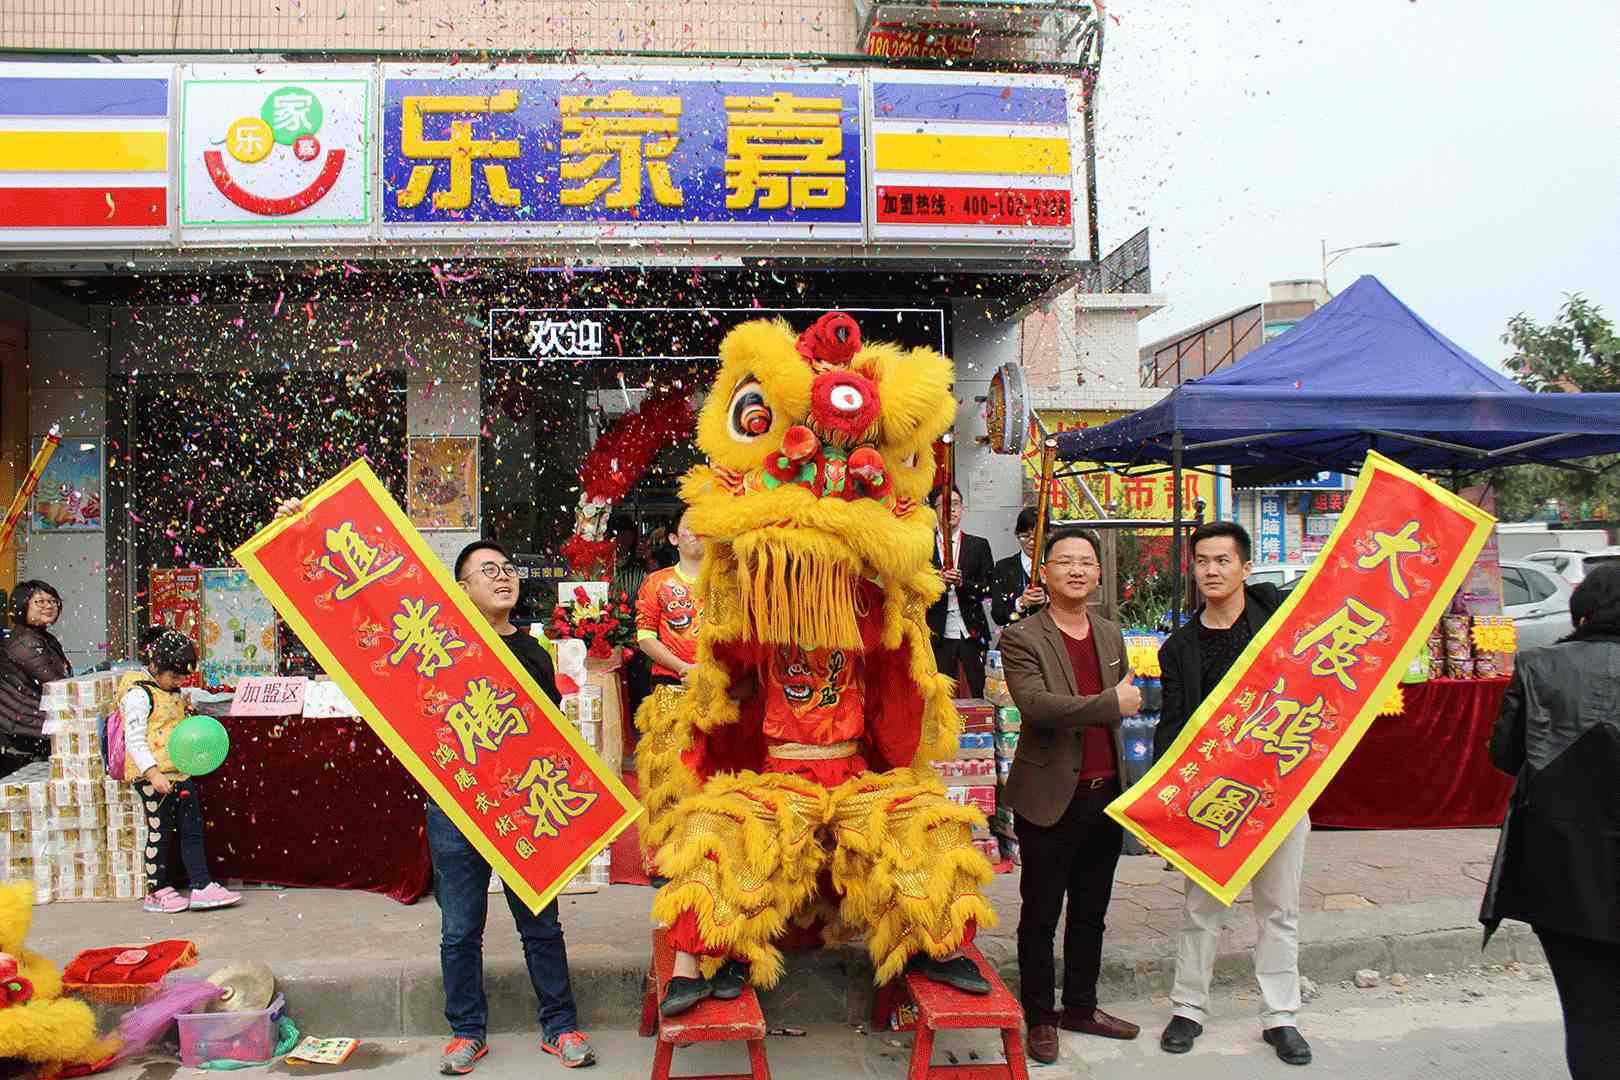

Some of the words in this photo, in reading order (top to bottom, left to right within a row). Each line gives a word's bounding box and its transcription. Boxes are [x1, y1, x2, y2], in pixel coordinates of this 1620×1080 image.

[273, 92, 312, 131] 家
[235, 125, 264, 153] 乐
[396, 89, 848, 209] 乐家嘉
[528, 318, 602, 356] 欢迎
[240, 682, 302, 703] 加盟区
